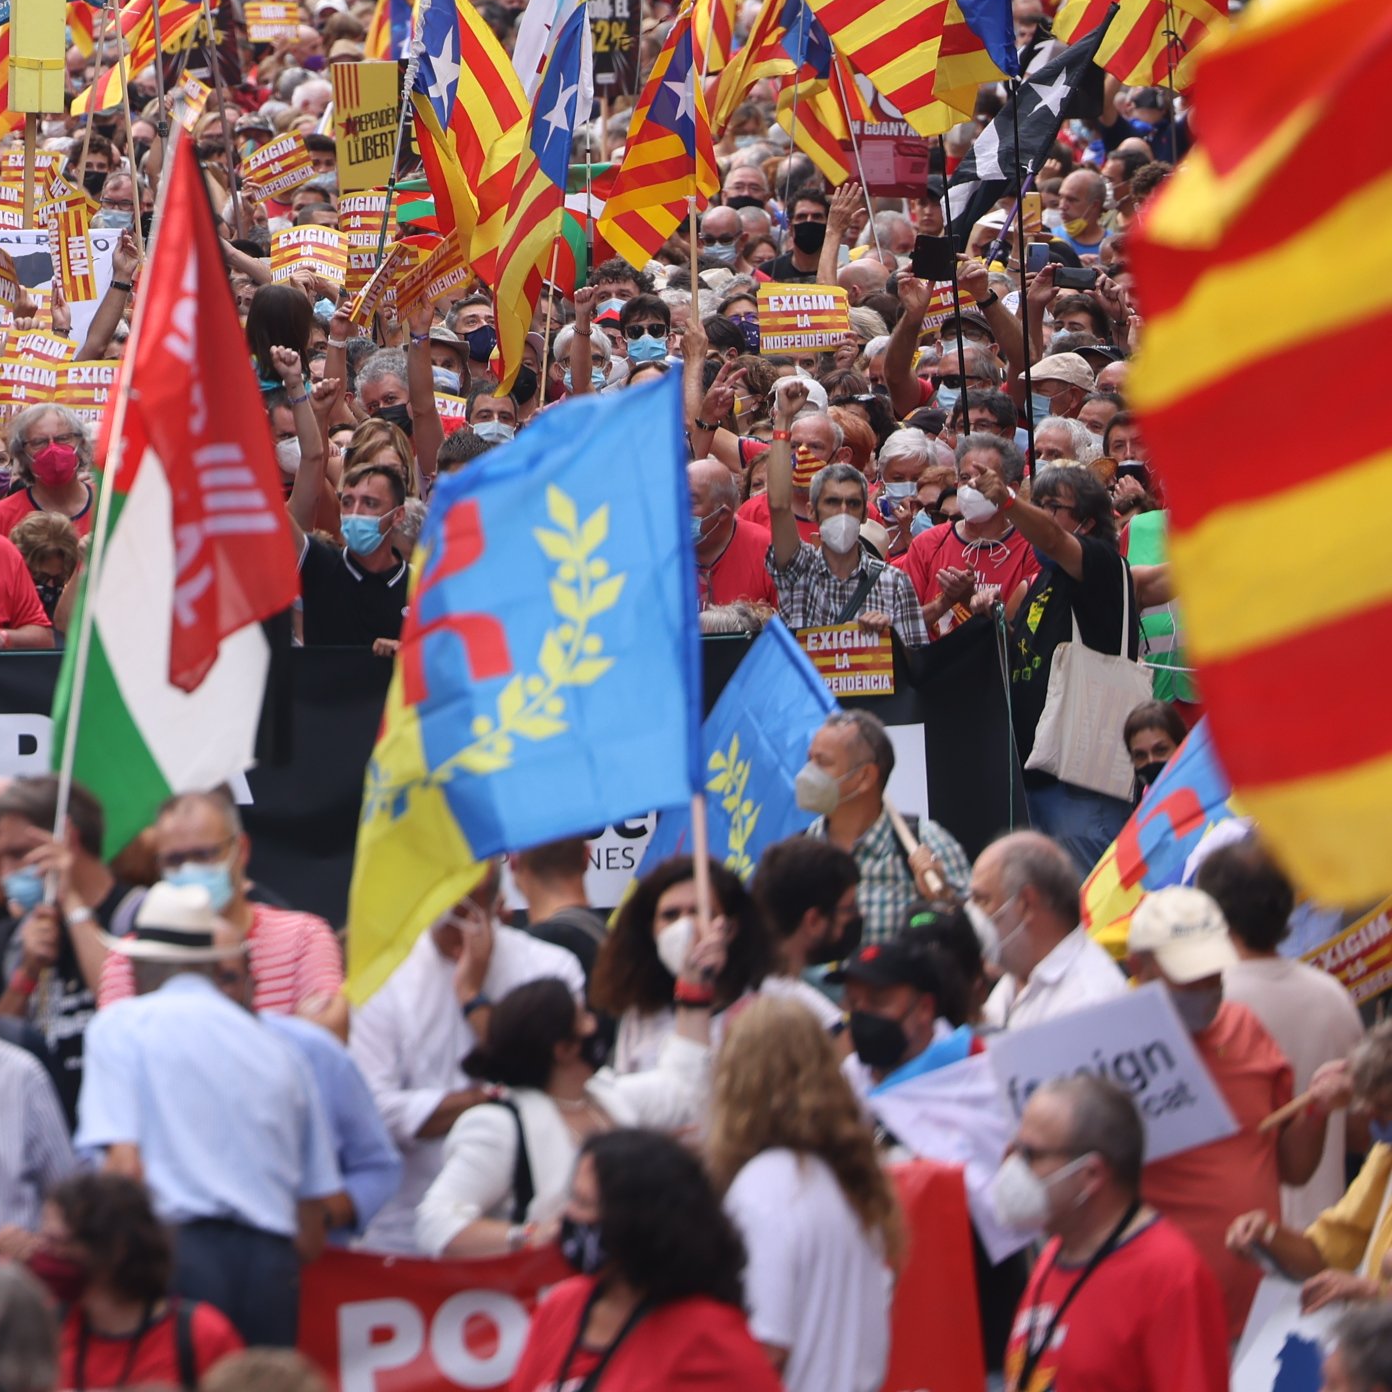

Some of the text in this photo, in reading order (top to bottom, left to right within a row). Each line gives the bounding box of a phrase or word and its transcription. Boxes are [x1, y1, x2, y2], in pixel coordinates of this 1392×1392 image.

[249, 137, 297, 170] EXIGIM
[269, 162, 282, 175] LA
[340, 196, 387, 212] EXIGIM
[349, 215, 361, 228] LA
[279, 230, 340, 249] EXIGIM
[68, 236, 90, 277] HEM
[300, 244, 314, 256] LA
[768, 295, 835, 312] EXIGIM
[939, 292, 954, 306] LA
[796, 314, 811, 329] LA
[16, 334, 68, 359] EXIGIM
[1, 366, 57, 388] XIGIM
[67, 367, 112, 385] EXIG
[11, 384, 25, 400] LA
[94, 386, 108, 403] LA
[835, 652, 850, 670] LA
